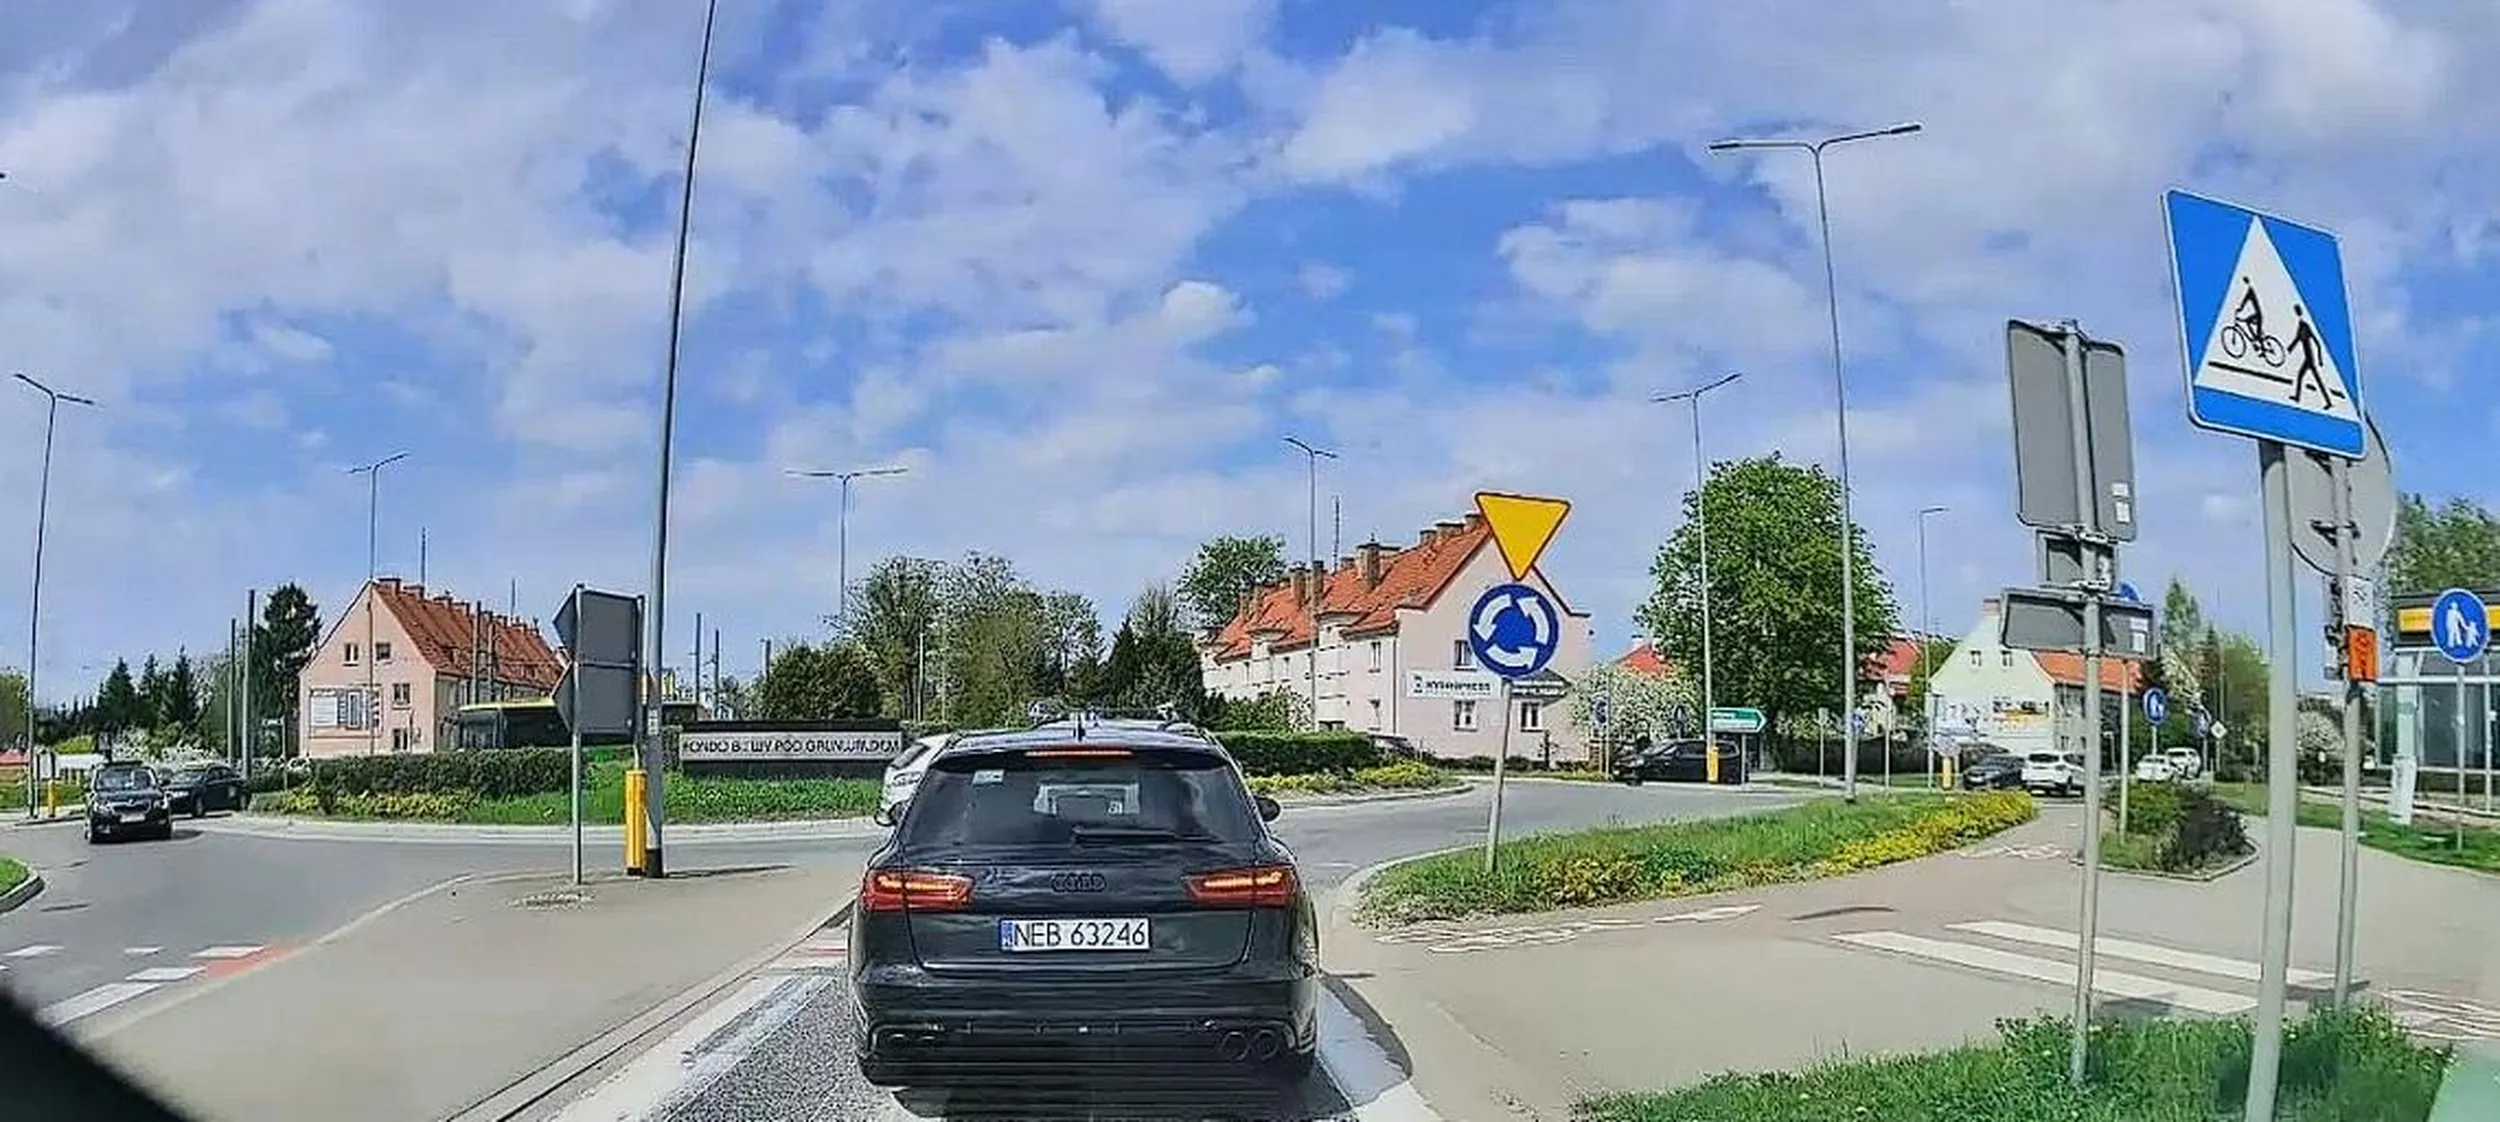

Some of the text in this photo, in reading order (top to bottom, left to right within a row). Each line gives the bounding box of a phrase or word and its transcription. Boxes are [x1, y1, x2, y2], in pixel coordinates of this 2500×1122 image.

[731, 740, 772, 753] BWY
[1014, 922, 1062, 947] NEB
[1070, 921, 1146, 946] 63246
